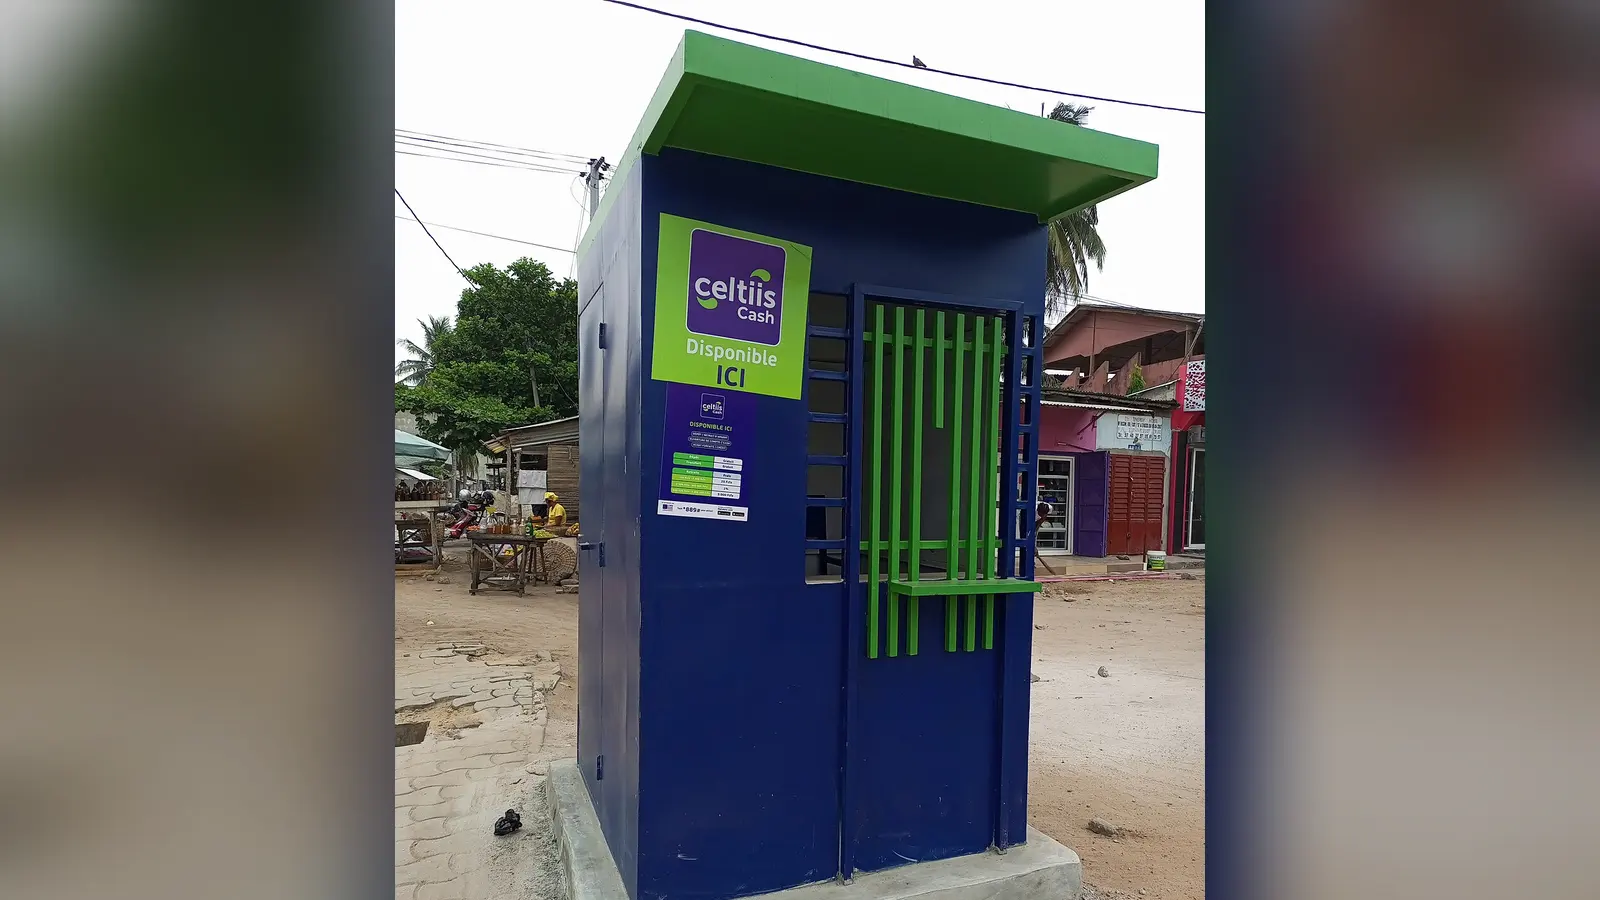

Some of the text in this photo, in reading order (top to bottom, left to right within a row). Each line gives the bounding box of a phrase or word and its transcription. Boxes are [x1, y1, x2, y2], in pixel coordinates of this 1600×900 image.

[694, 276, 776, 309] celtiis
[737, 306, 775, 325] Cash
[686, 338, 778, 367] Disponible
[716, 365, 746, 388] ICI
[689, 421, 724, 430] DISPONIBLE
